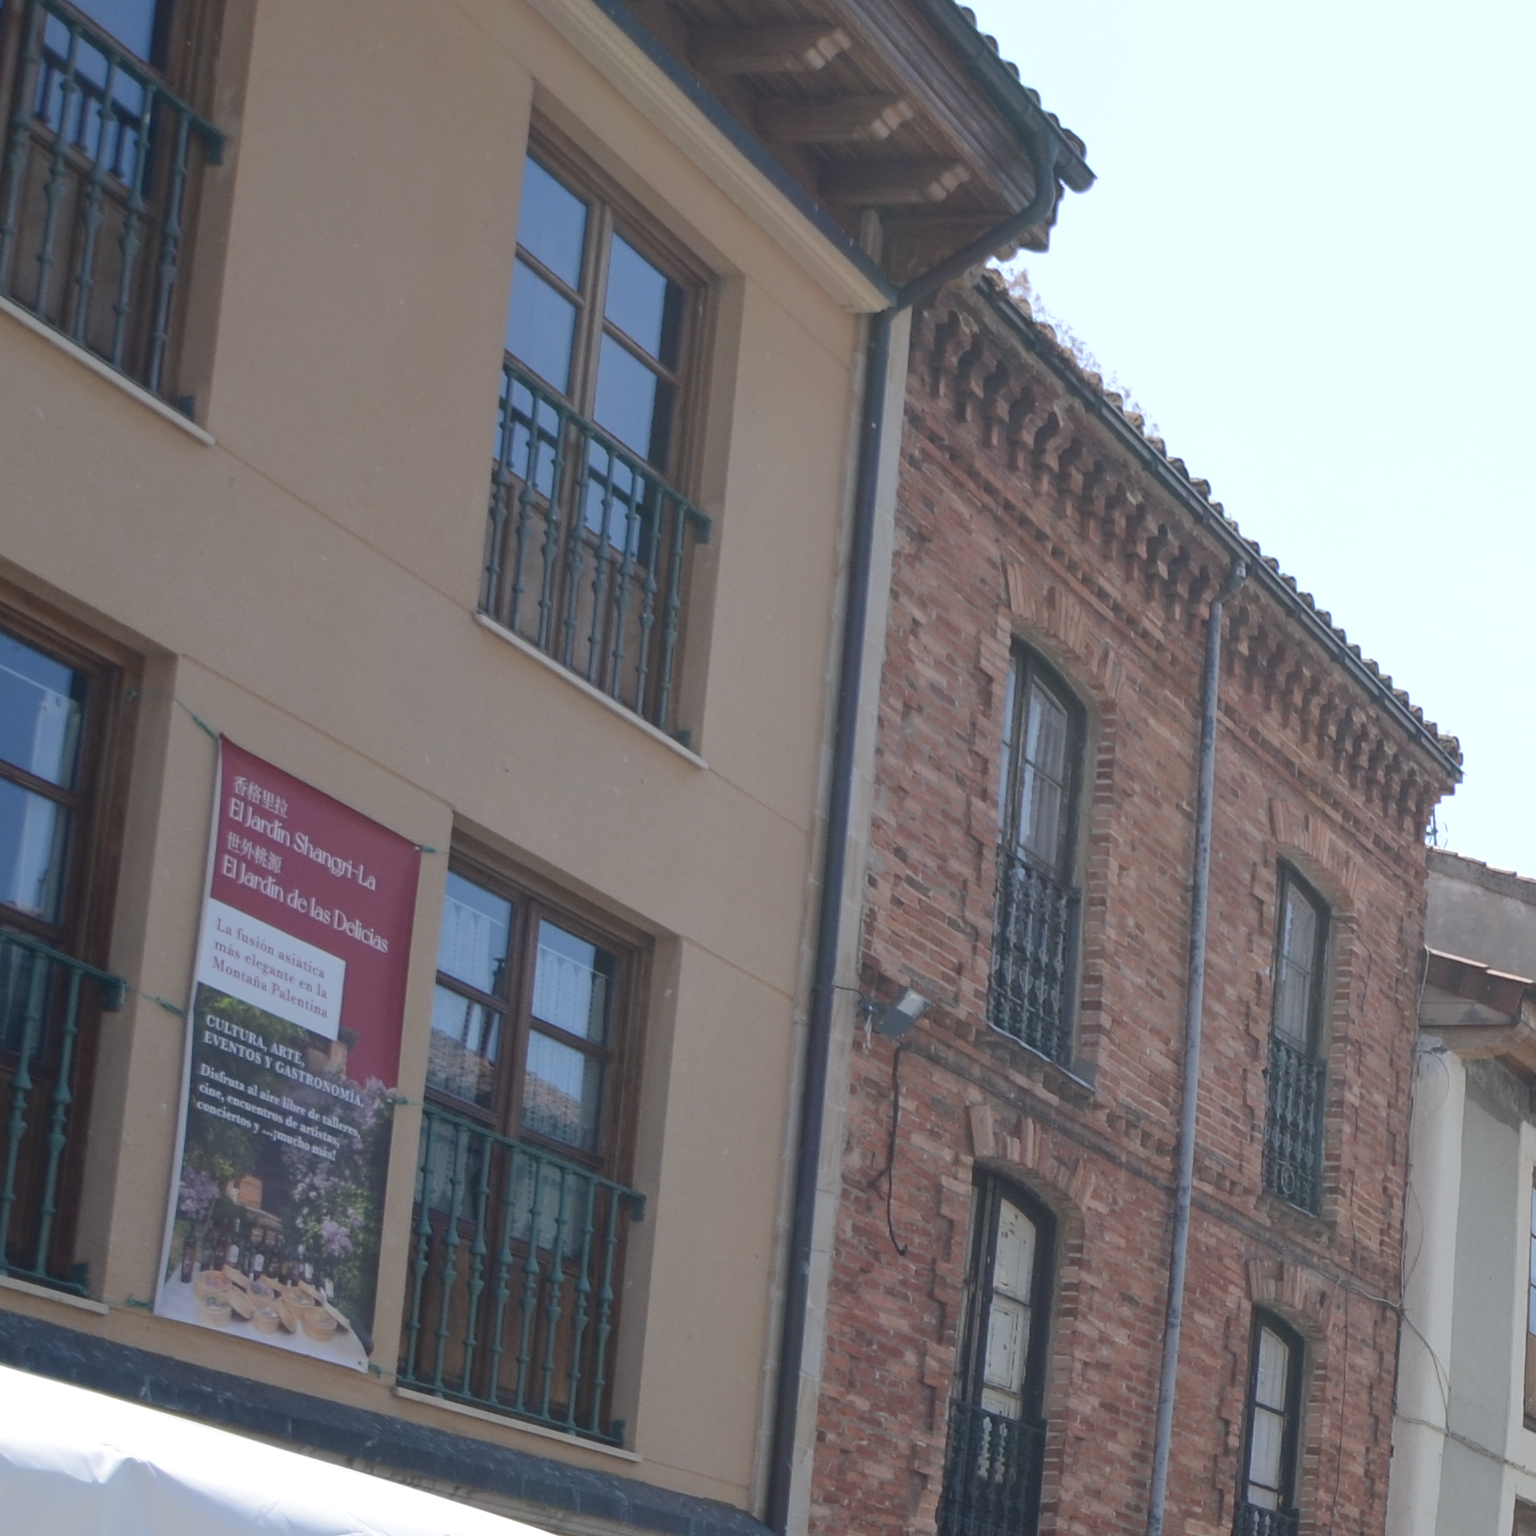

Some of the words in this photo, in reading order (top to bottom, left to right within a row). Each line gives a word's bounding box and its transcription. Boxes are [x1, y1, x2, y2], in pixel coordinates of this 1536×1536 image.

[234, 775, 288, 819] 香格里拉
[227, 832, 282, 874] 世外桃源
[229, 797, 244, 822] El
[244, 806, 291, 847] Jardín
[293, 832, 376, 891] Shangri-La
[222, 854, 237, 879] El
[238, 863, 284, 903] Jardín
[287, 889, 308, 913] de
[310, 897, 331, 925] las
[333, 909, 389, 953] Delicias
[214, 941, 240, 959] más
[245, 954, 295, 984] elegante
[299, 980, 313, 993] en
[317, 984, 328, 999] la
[216, 918, 232, 936] La
[236, 928, 274, 956] fusión
[278, 951, 325, 979] asiática
[212, 956, 267, 991] Montaña
[271, 983, 328, 1018] Palentina
[203, 1031, 262, 1065] EVENTOS
[264, 1056, 274, 1069] Y
[275, 1061, 365, 1108] GASTRONOMÍA.
[206, 1014, 267, 1052] CULTURA,
[270, 1042, 305, 1068] ARTE,
[196, 1100, 252, 1129] conciertos
[253, 1122, 261, 1134] y
[199, 1082, 225, 1102] cine,
[227, 1094, 284, 1124] encuentros
[285, 1116, 298, 1130] de
[300, 1122, 340, 1148] artistas,
[200, 1063, 245, 1091] Disfruta
[247, 1084, 258, 1097] al
[259, 1089, 280, 1106] aire
[282, 1096, 307, 1117] libre
[308, 1109, 321, 1122] de
[322, 1114, 361, 1139] talleres,
